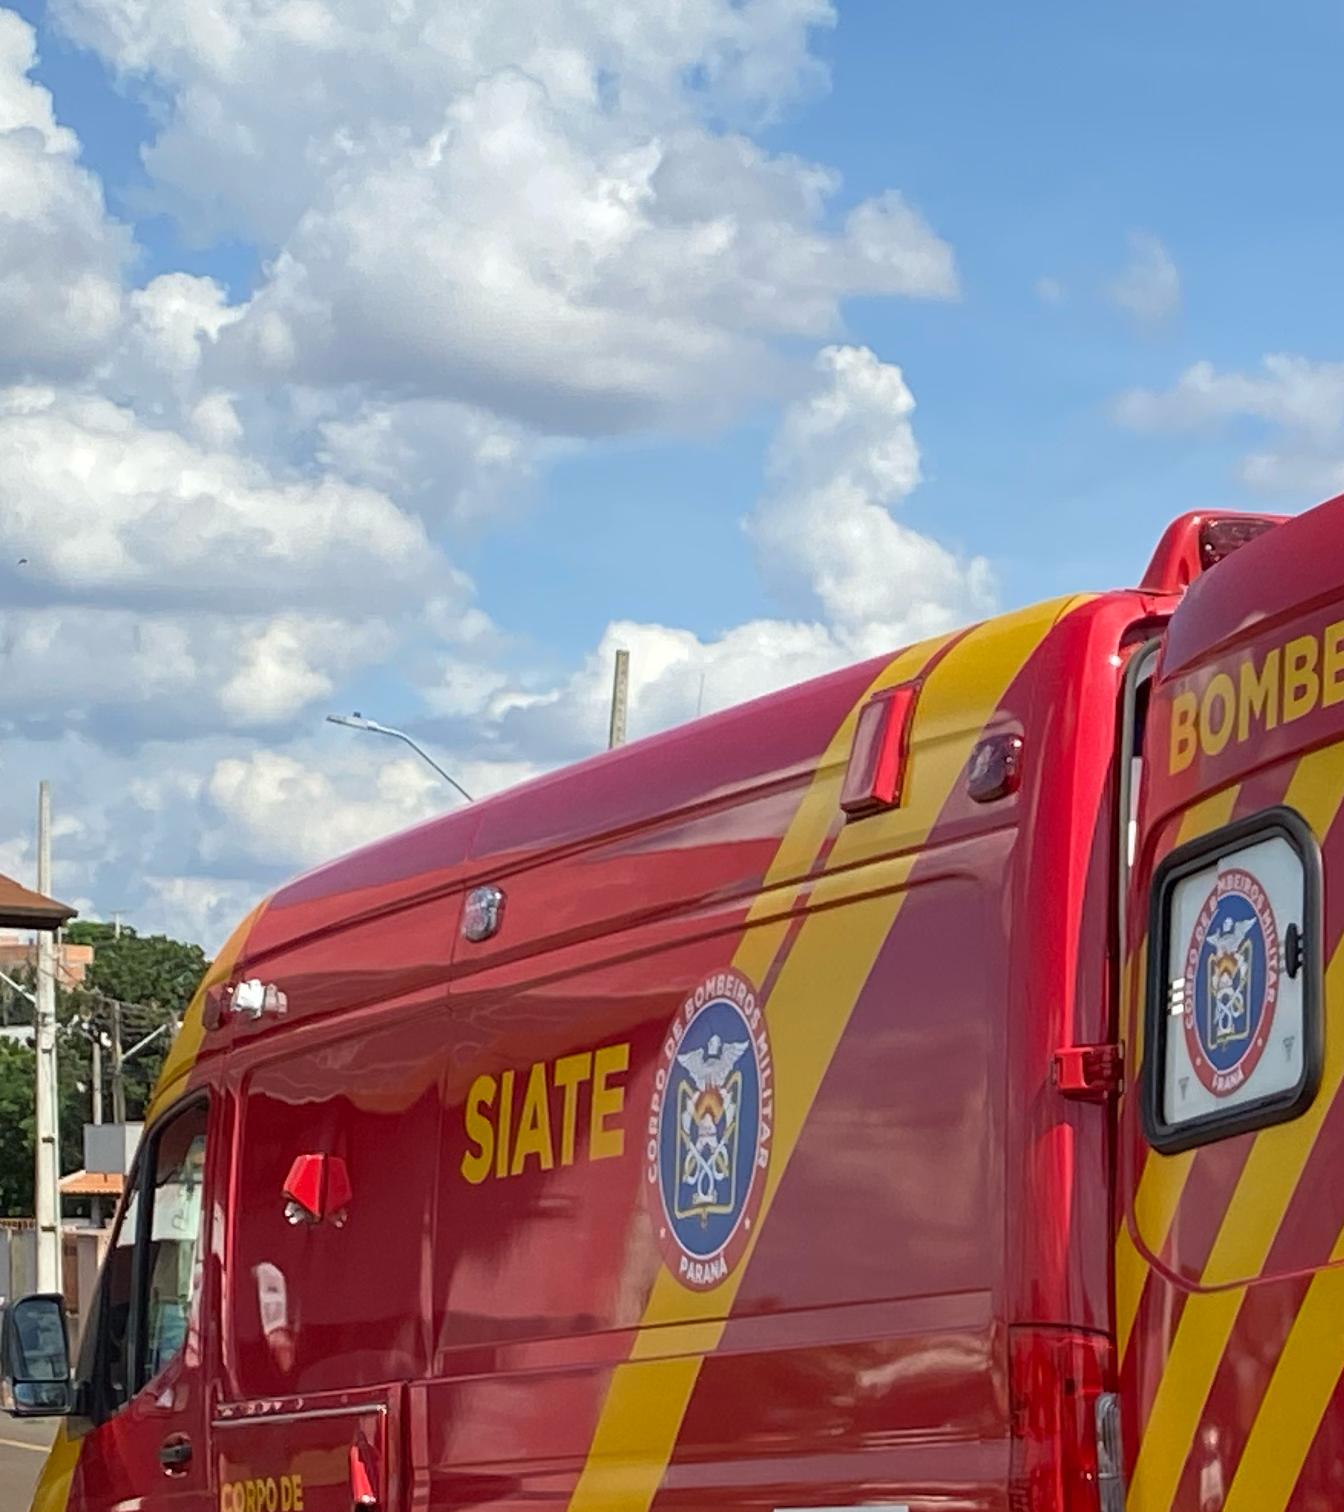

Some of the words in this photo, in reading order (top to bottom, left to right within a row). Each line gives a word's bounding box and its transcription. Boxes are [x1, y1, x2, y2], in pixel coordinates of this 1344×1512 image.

[461, 1042, 630, 1184] SIATE
[647, 1067, 667, 1184] CORPO
[664, 1018, 683, 1060] DE
[685, 974, 761, 1030] BOMBEIROS
[756, 1031, 773, 1170] MILITAR
[679, 1250, 728, 1284] PARANÁ
[281, 1474, 304, 1512] DE
